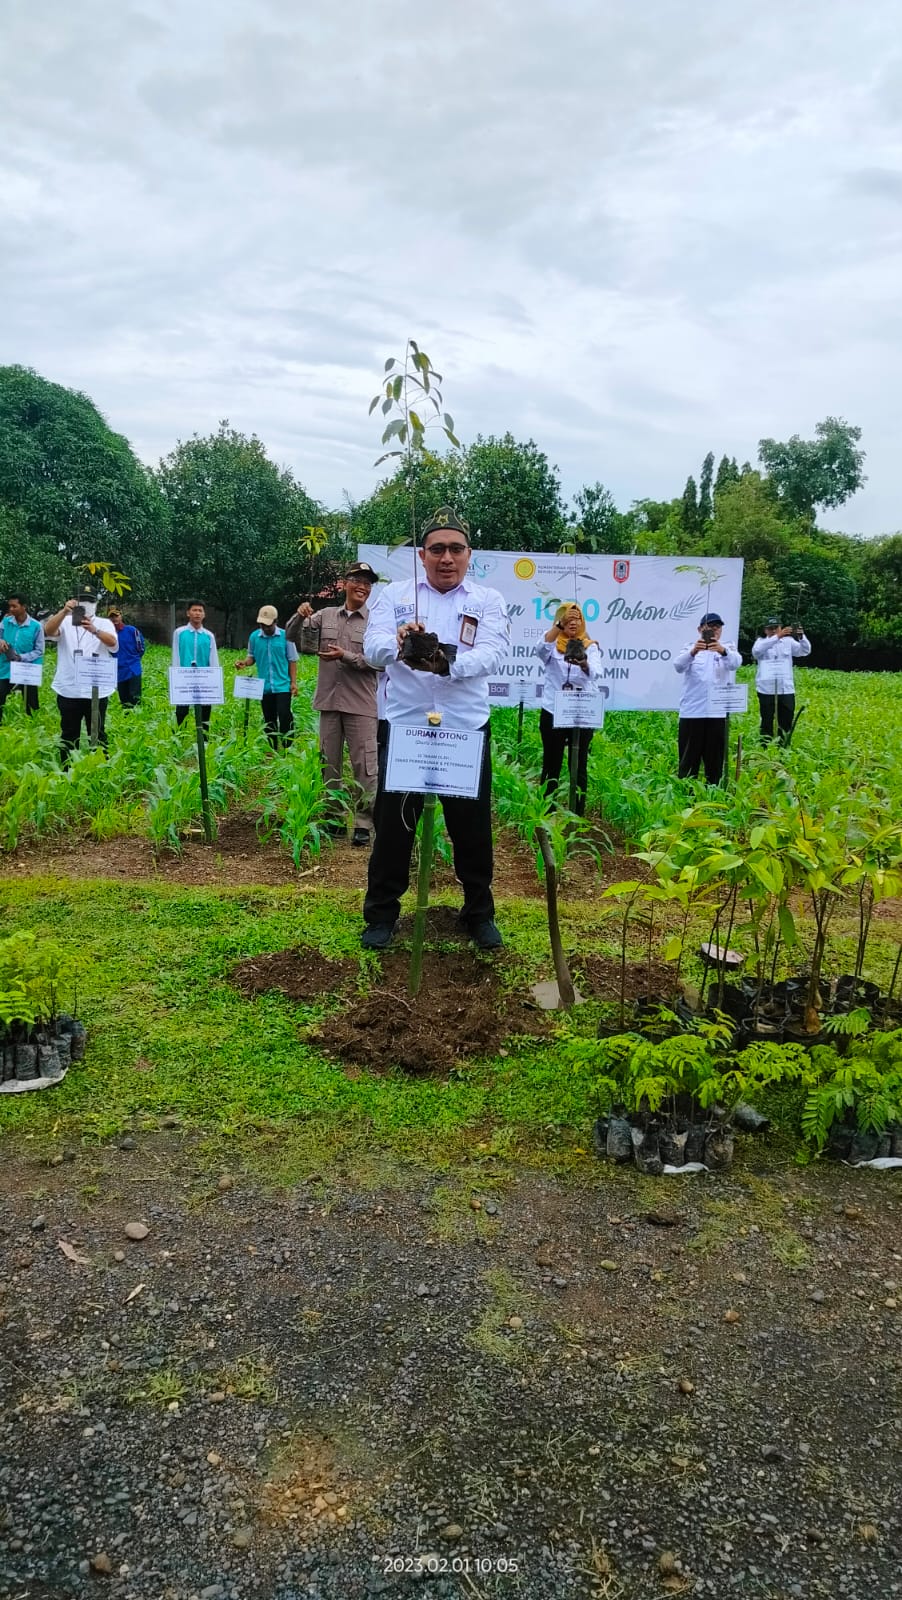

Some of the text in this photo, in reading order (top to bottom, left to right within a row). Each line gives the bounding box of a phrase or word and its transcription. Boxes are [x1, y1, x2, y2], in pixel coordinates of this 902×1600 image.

[604, 597, 669, 624] Pohon
[608, 648, 672, 661] WIDODO
[405, 729, 468, 741] DURIAN OTONG
